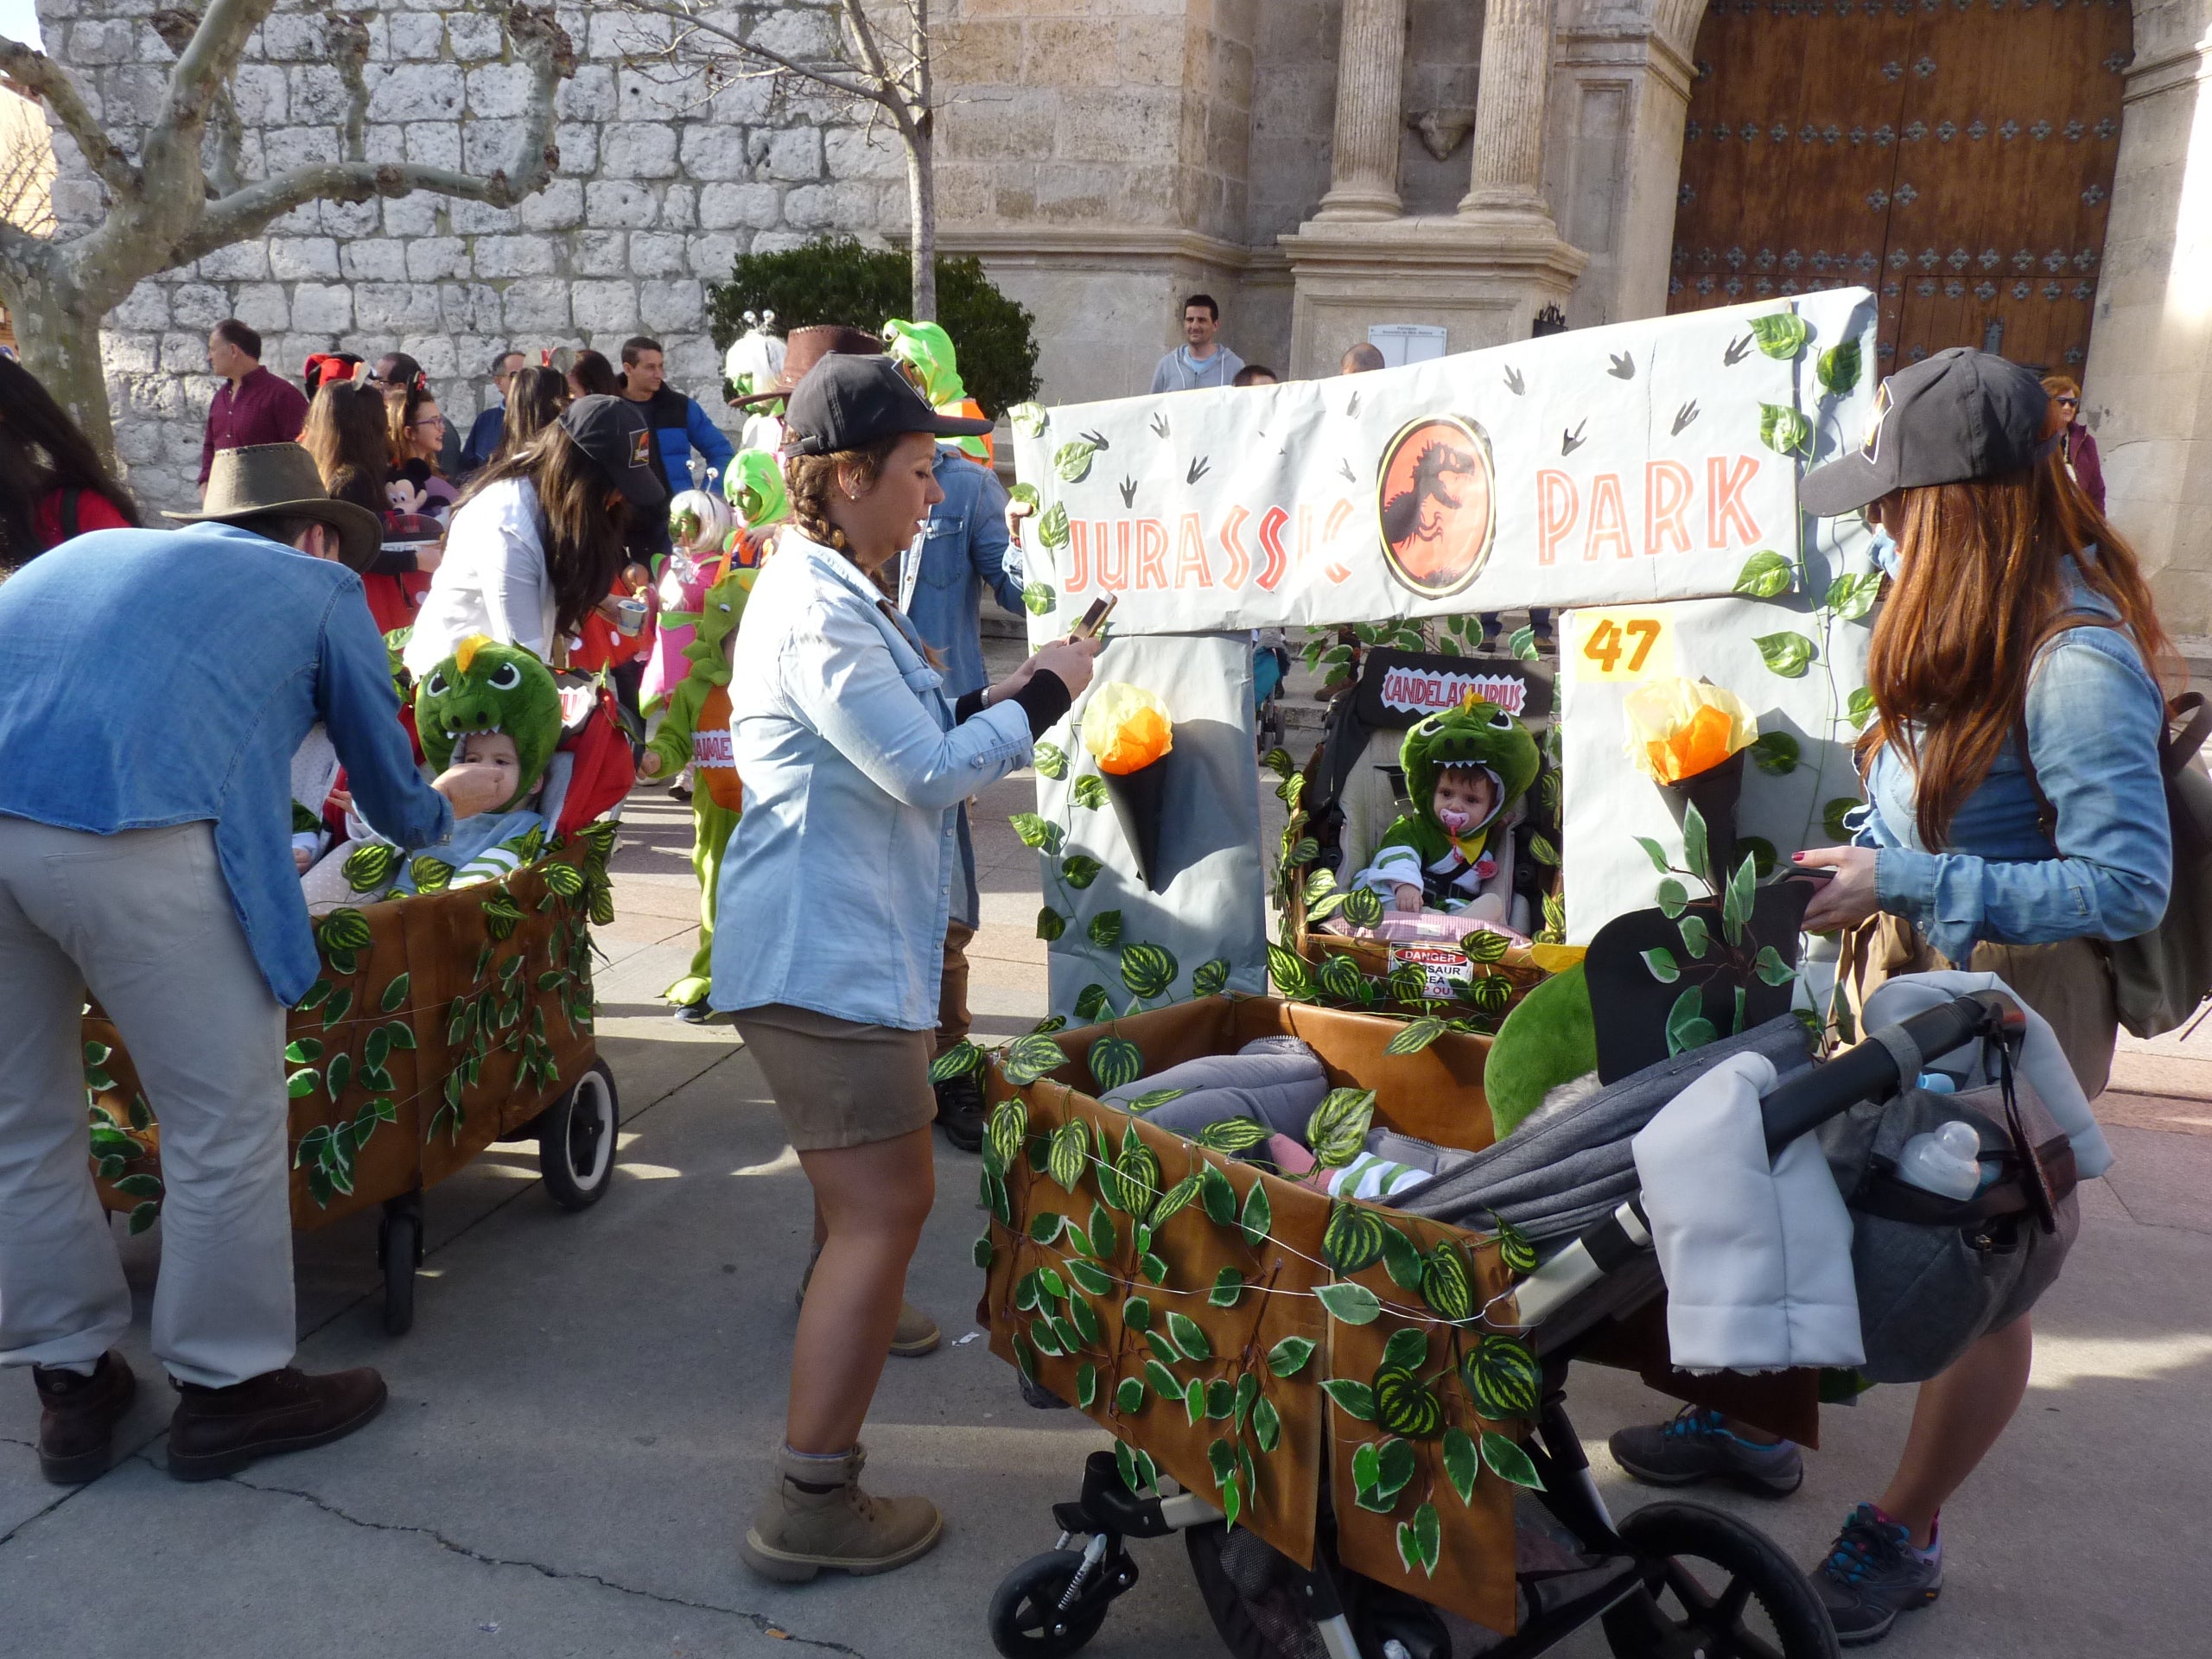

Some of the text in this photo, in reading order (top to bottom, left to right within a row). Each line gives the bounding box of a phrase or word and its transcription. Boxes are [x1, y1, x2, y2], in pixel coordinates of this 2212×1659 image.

[1065, 454, 1764, 593] JURASSIC PARK
[1583, 619, 1662, 672] 47
[1404, 950, 1456, 963] DANGER
[1424, 964, 1461, 976] SAUR
